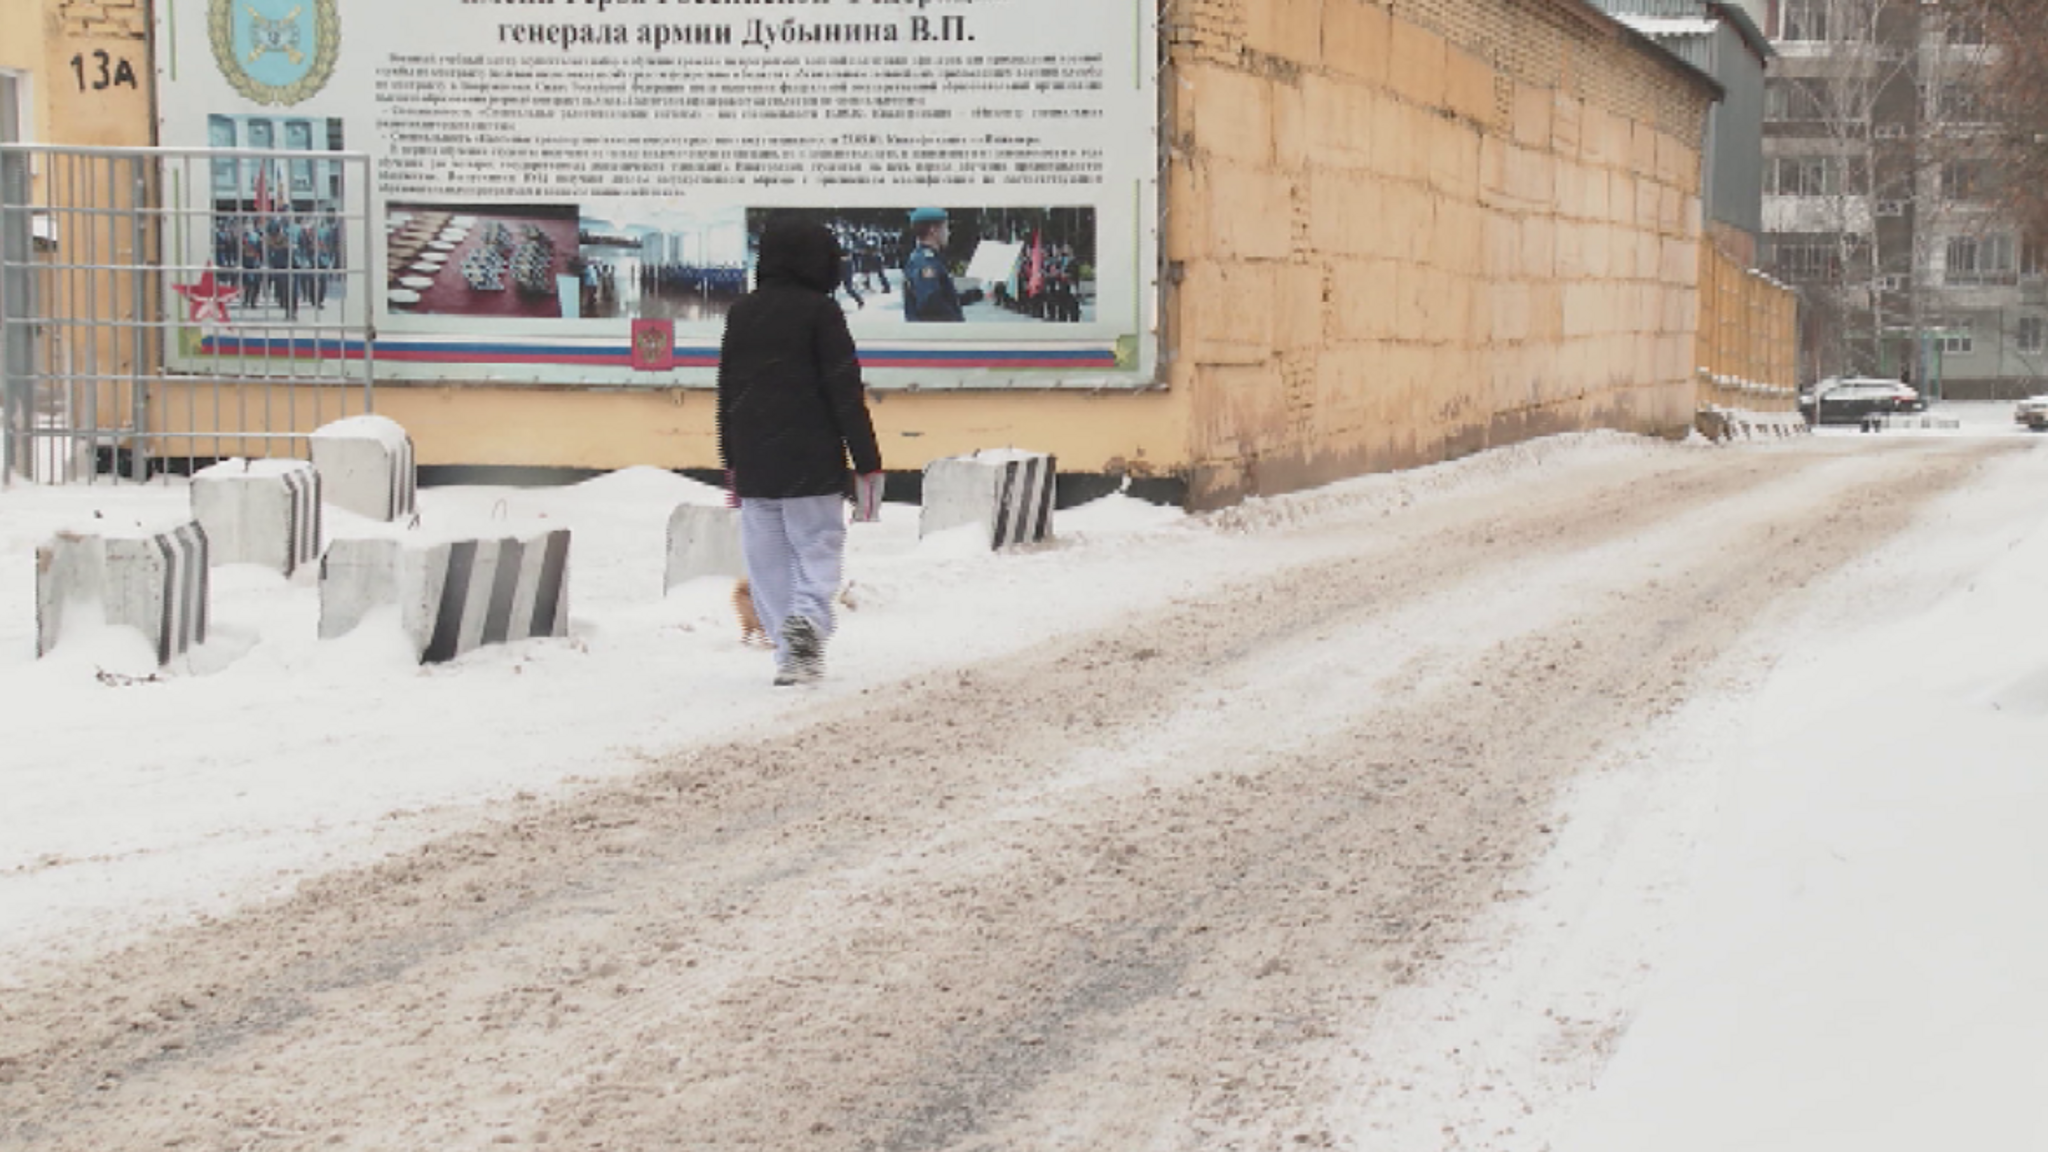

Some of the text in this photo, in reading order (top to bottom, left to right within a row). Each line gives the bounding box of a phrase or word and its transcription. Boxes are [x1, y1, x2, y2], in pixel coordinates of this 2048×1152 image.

[498, 15, 976, 50] генерала армии Дубынина В.П.
[70, 48, 138, 92] 13А
